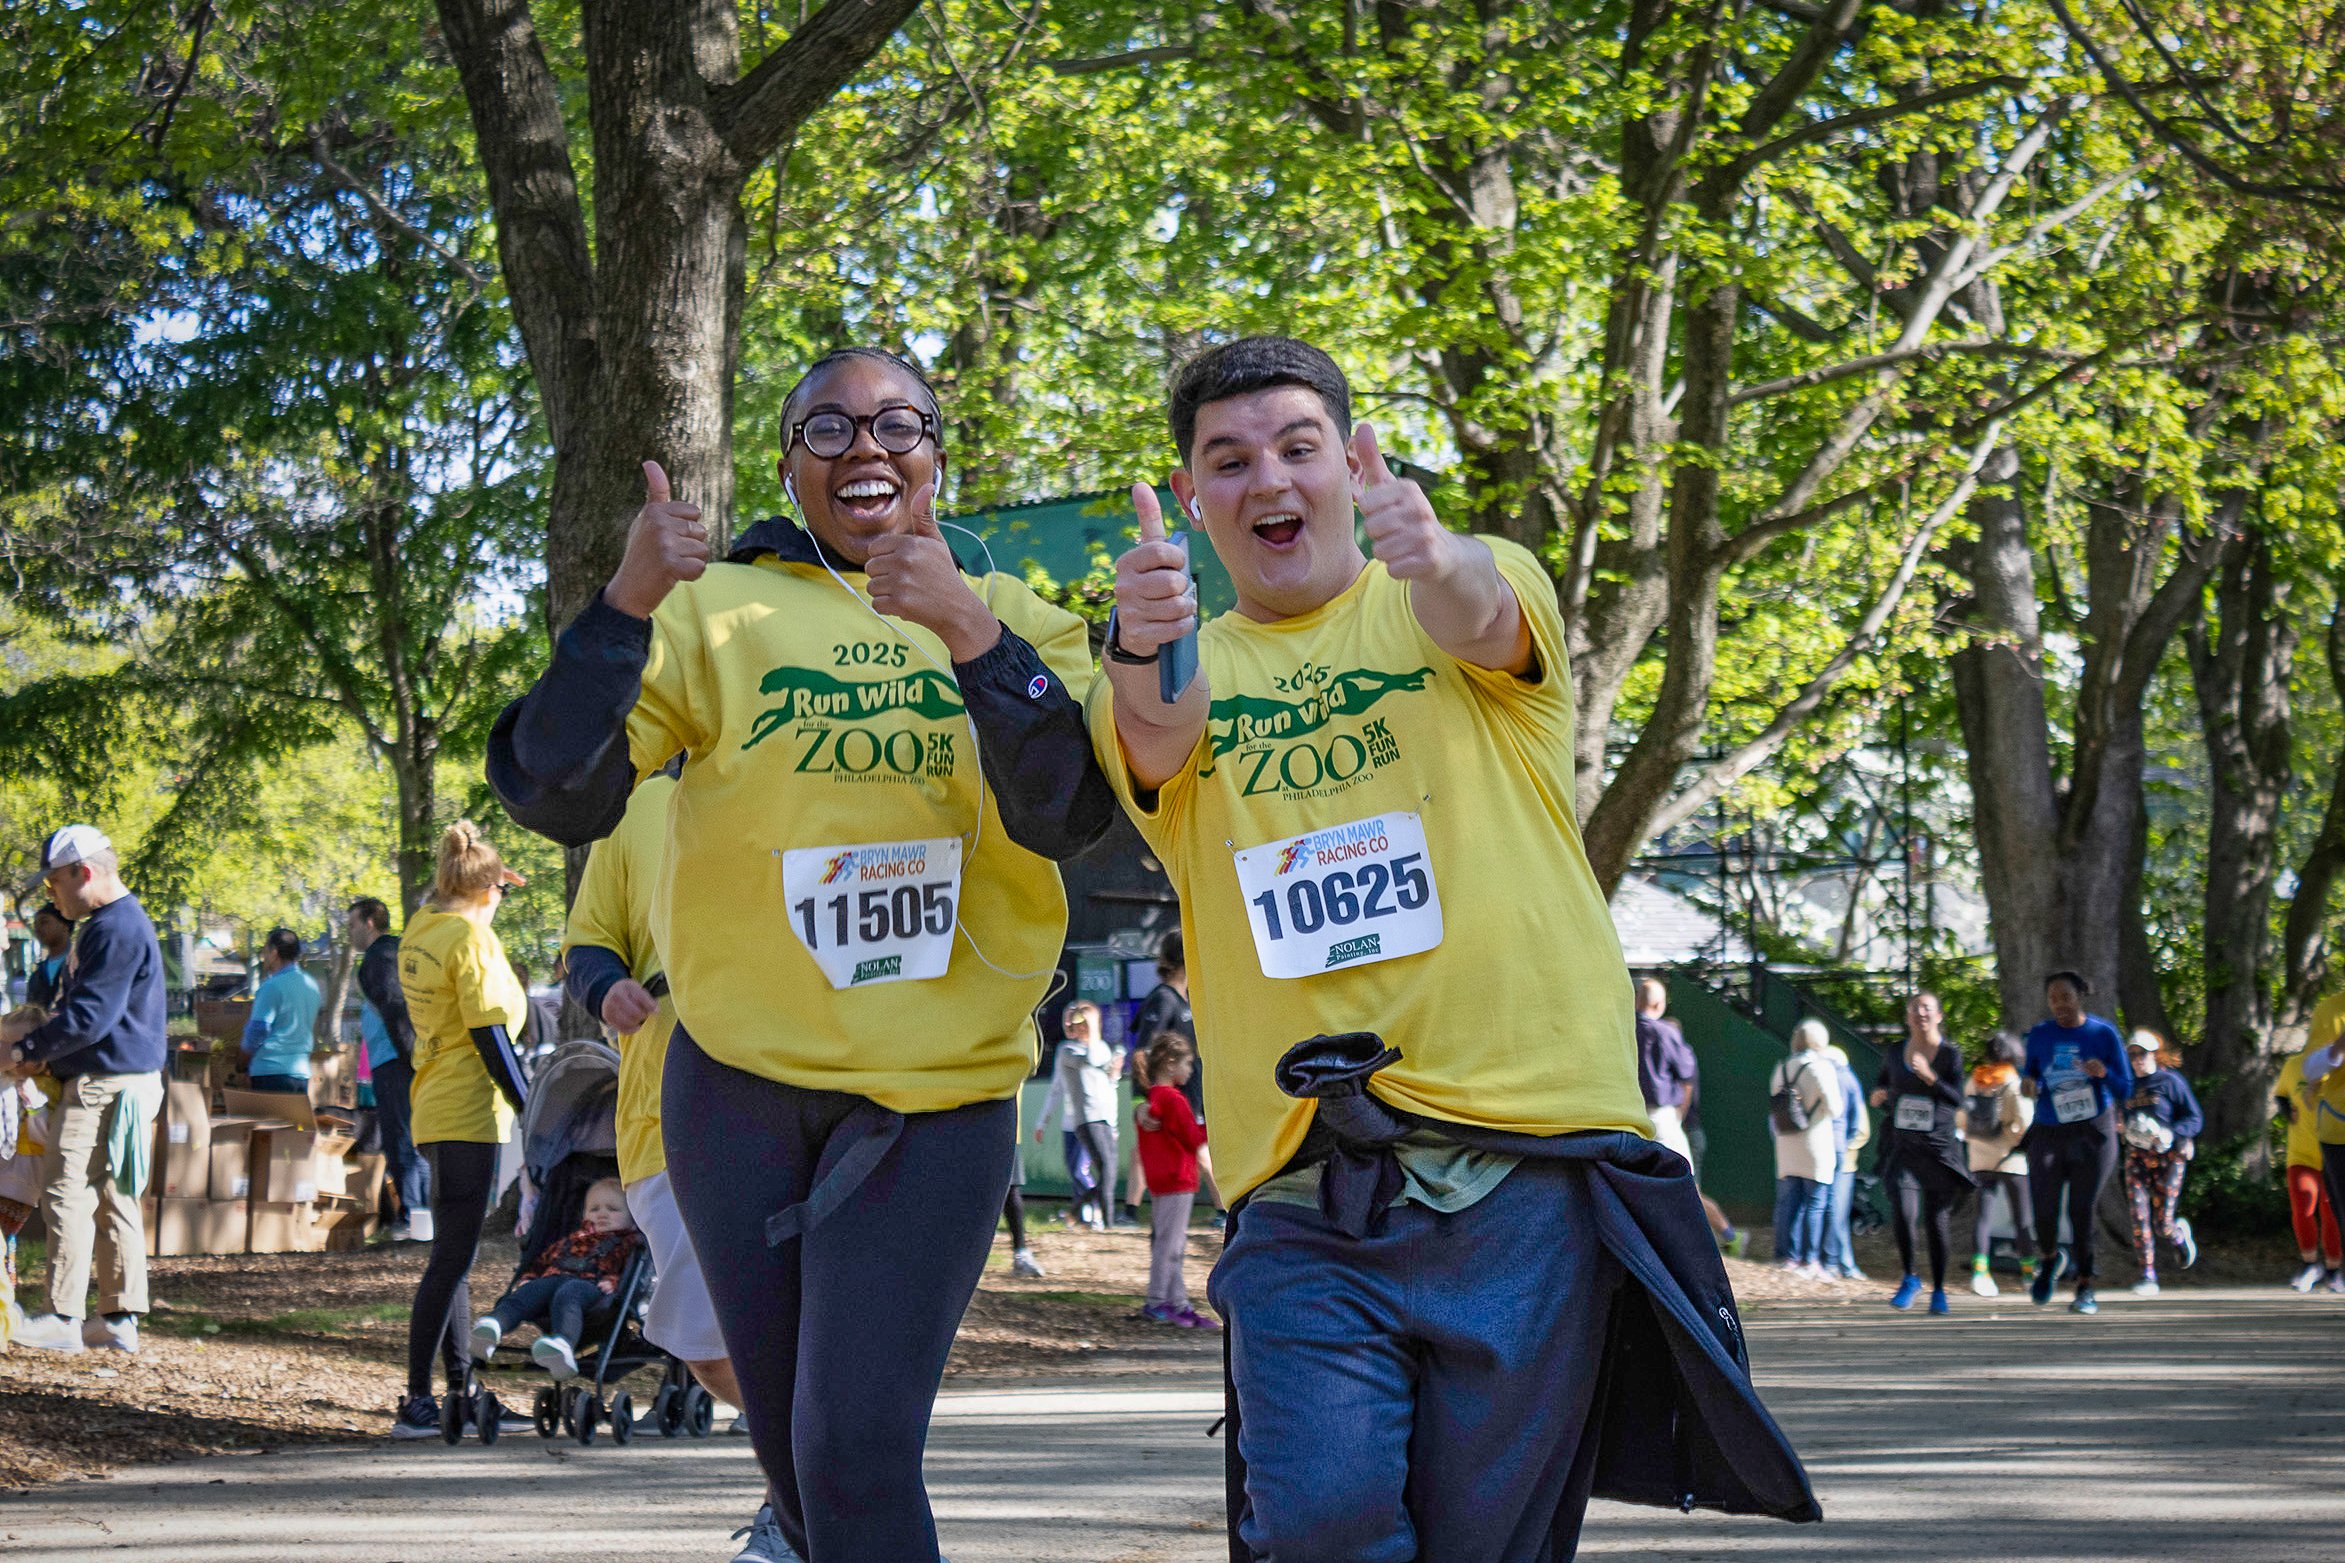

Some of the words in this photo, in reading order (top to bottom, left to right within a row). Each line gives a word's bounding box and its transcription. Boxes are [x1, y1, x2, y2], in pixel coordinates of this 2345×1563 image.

[833, 642, 909, 668] 2025
[793, 688, 850, 718] Run
[857, 677, 924, 712] Wild
[1237, 710, 1292, 744] Run
[1361, 716, 1392, 744] 5K
[794, 728, 925, 775] ZOO
[927, 731, 955, 753] 5K
[1246, 742, 1257, 752] for
[1259, 741, 1272, 750] the
[1368, 735, 1398, 756] FUN
[926, 764, 954, 778] RUN
[927, 751, 955, 767] FUN
[1239, 734, 1367, 798] ZOO
[1372, 747, 1401, 770] RUN
[834, 773, 907, 785] PHILADELPHIA
[1282, 782, 1352, 802] PHILADELPHIA
[1353, 772, 1375, 786] ZOO
[1313, 829, 1346, 851] BRYN
[1346, 819, 1386, 844] MAWR
[860, 848, 890, 865] BRYN
[891, 843, 927, 863] MAWR
[1316, 841, 1367, 867] RACING
[1368, 835, 1389, 854] CO
[860, 861, 906, 882] RACING
[907, 858, 926, 877] CO
[1252, 851, 1430, 941] 10625
[794, 881, 954, 950] 11505
[1334, 937, 1378, 955] NOLAN
[861, 957, 899, 972] NOLAN
